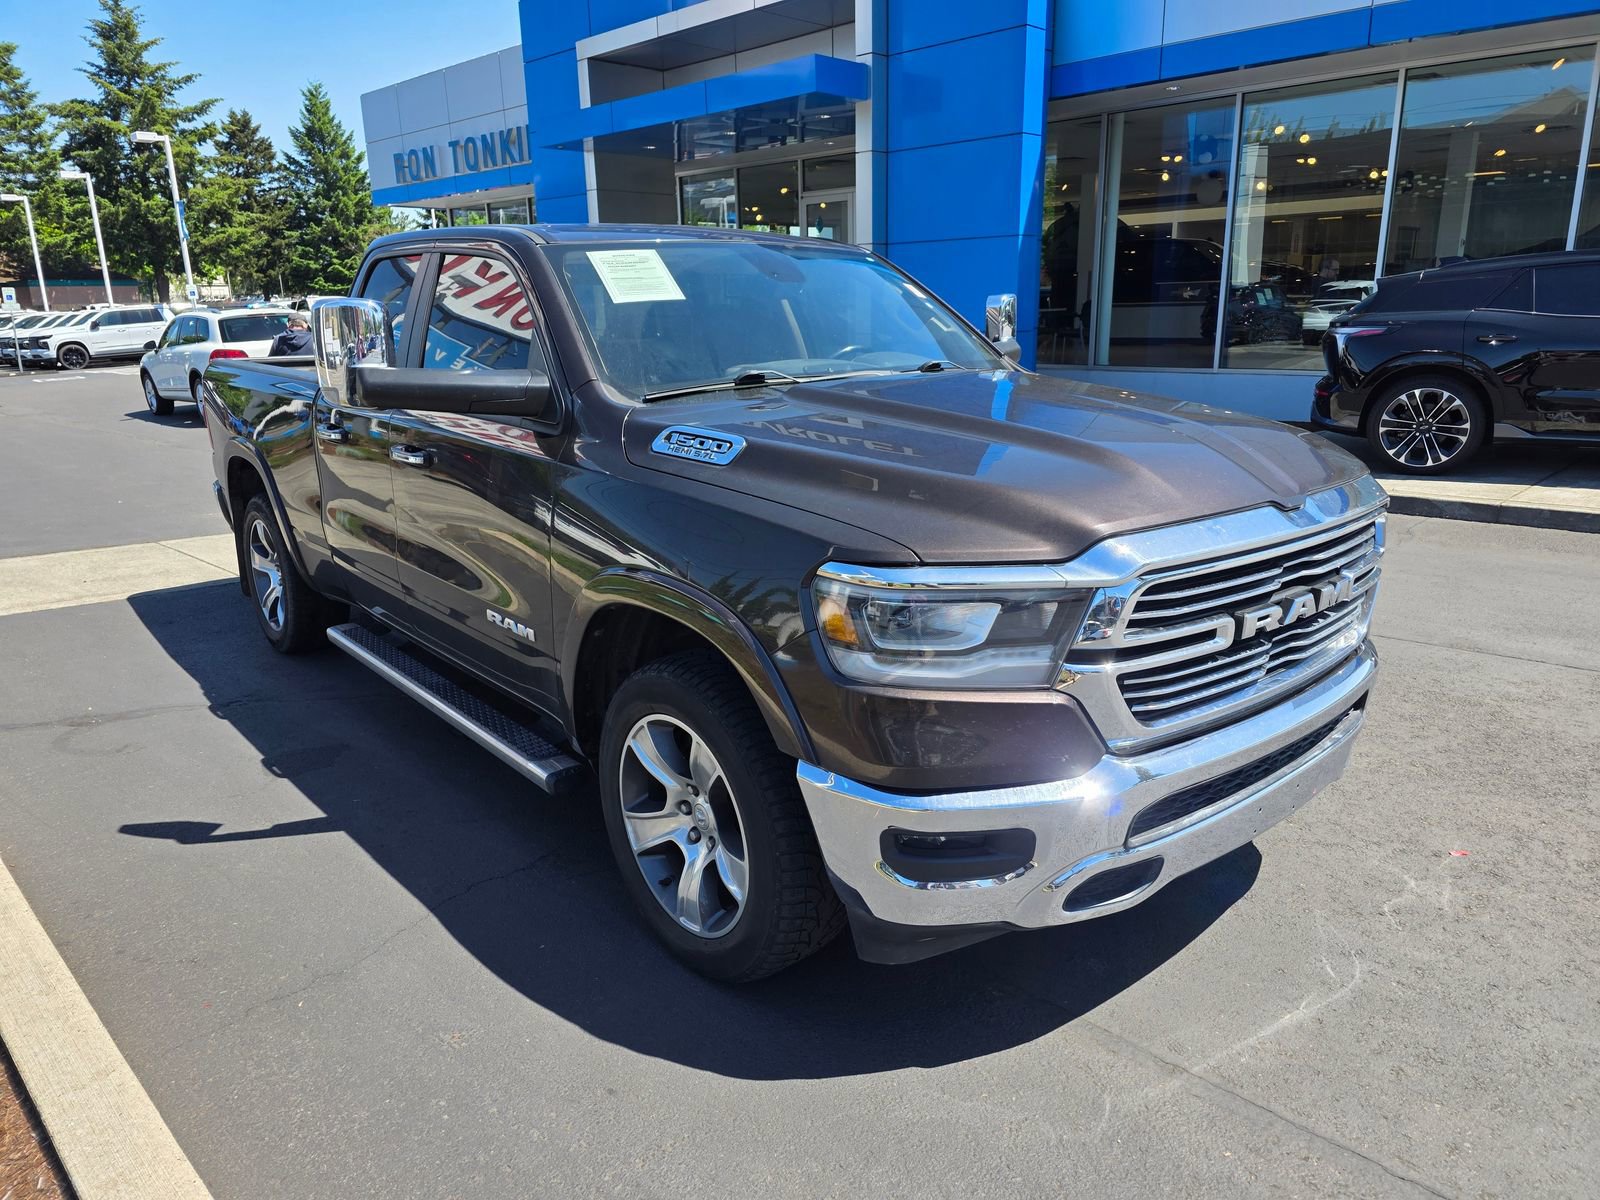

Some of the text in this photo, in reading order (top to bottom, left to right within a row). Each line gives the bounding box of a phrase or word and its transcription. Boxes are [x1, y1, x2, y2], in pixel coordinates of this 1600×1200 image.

[393, 124, 532, 184] RON TONKI
[667, 444, 716, 461] HEMI 5.7L
[669, 432, 730, 453] 1500
[1235, 575, 1353, 640] RAM
[486, 608, 536, 642] RAM
